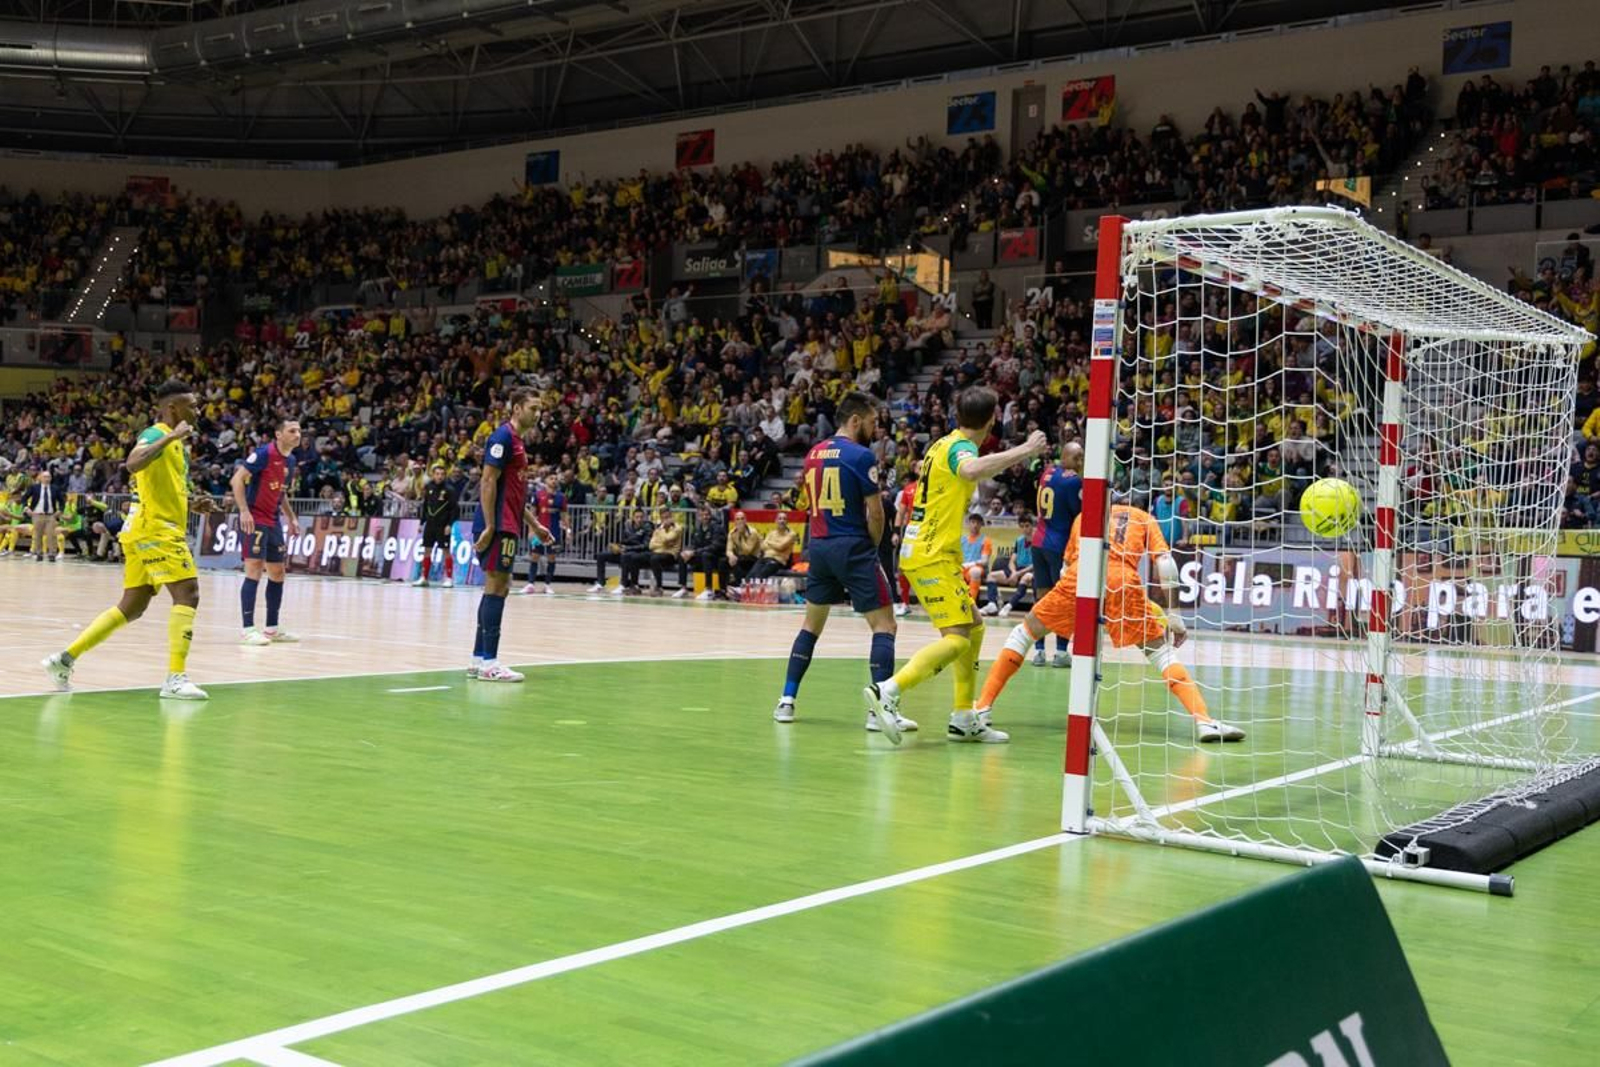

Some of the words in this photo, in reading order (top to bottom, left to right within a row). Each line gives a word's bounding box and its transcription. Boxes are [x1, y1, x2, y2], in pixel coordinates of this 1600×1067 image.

[1442, 27, 1485, 42] Sector
[684, 255, 727, 273] Salida
[805, 467, 846, 517] 14
[254, 530, 264, 545] 7
[501, 537, 516, 558] 10
[321, 534, 376, 567] para
[1179, 560, 1273, 607] Sala
[1427, 581, 1549, 629] para
